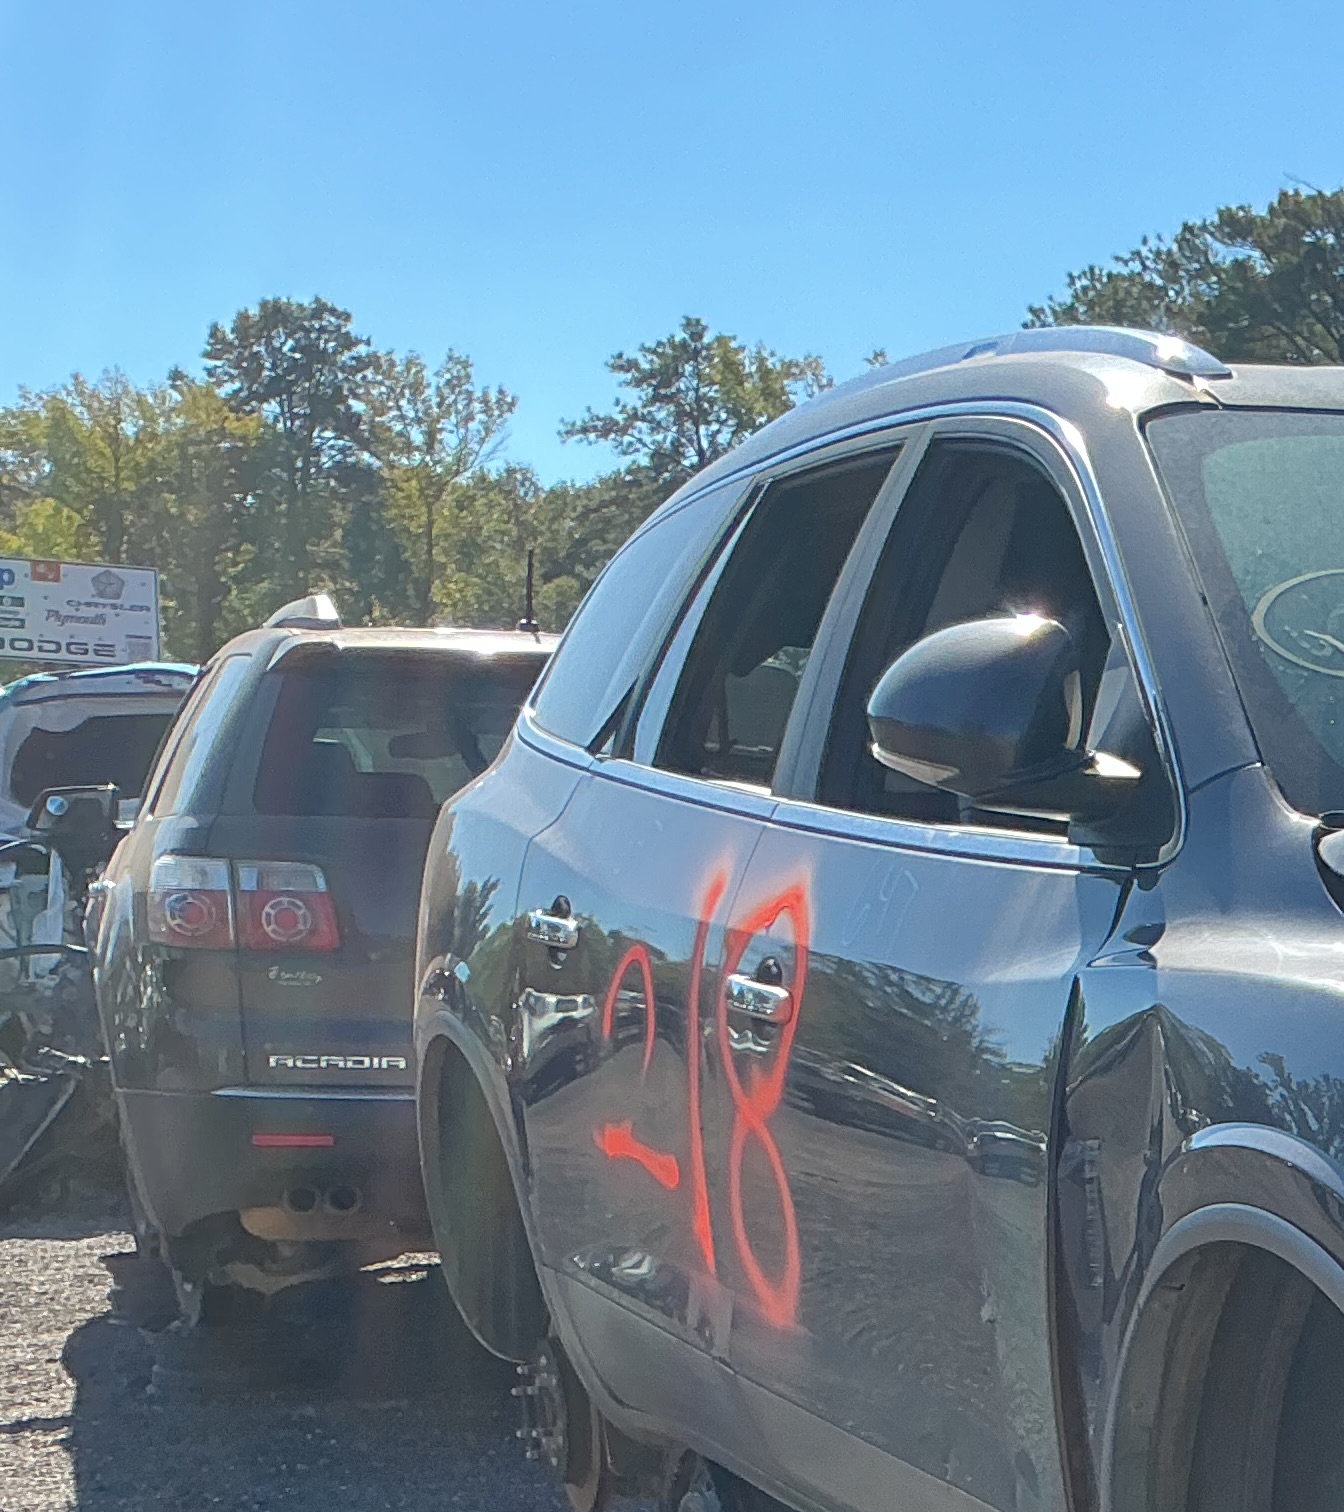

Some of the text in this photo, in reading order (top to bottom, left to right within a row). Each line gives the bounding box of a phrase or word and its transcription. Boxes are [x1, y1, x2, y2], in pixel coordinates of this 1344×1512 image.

[45, 608, 107, 627] Plymouth
[0, 637, 116, 658] ODGE
[269, 1055, 407, 1070] ACADIA
